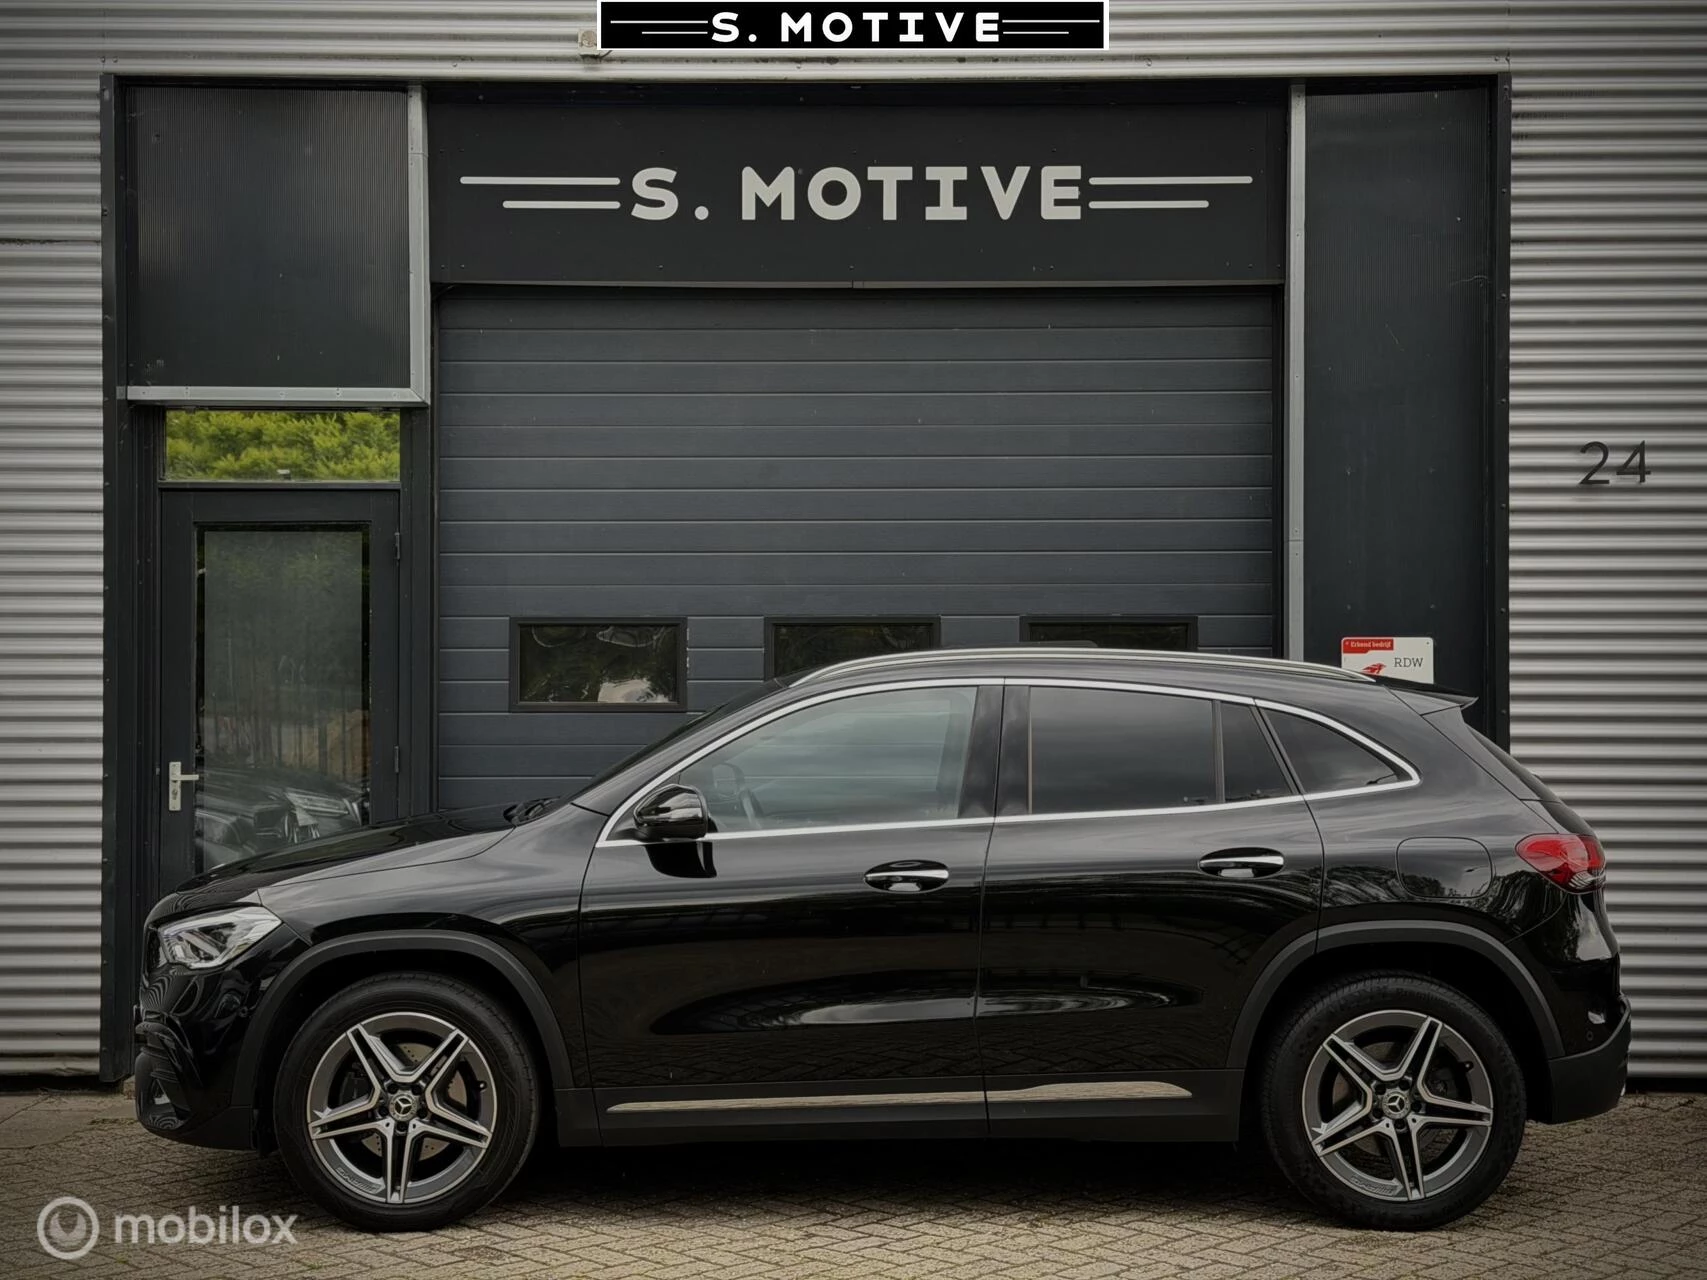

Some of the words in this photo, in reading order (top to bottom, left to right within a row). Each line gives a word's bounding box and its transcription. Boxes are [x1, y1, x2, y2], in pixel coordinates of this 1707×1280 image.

[631, 167, 709, 221] S.
[741, 166, 1082, 221] MOTIVE
[1579, 440, 1651, 484] 24
[1394, 657, 1424, 668] RDW
